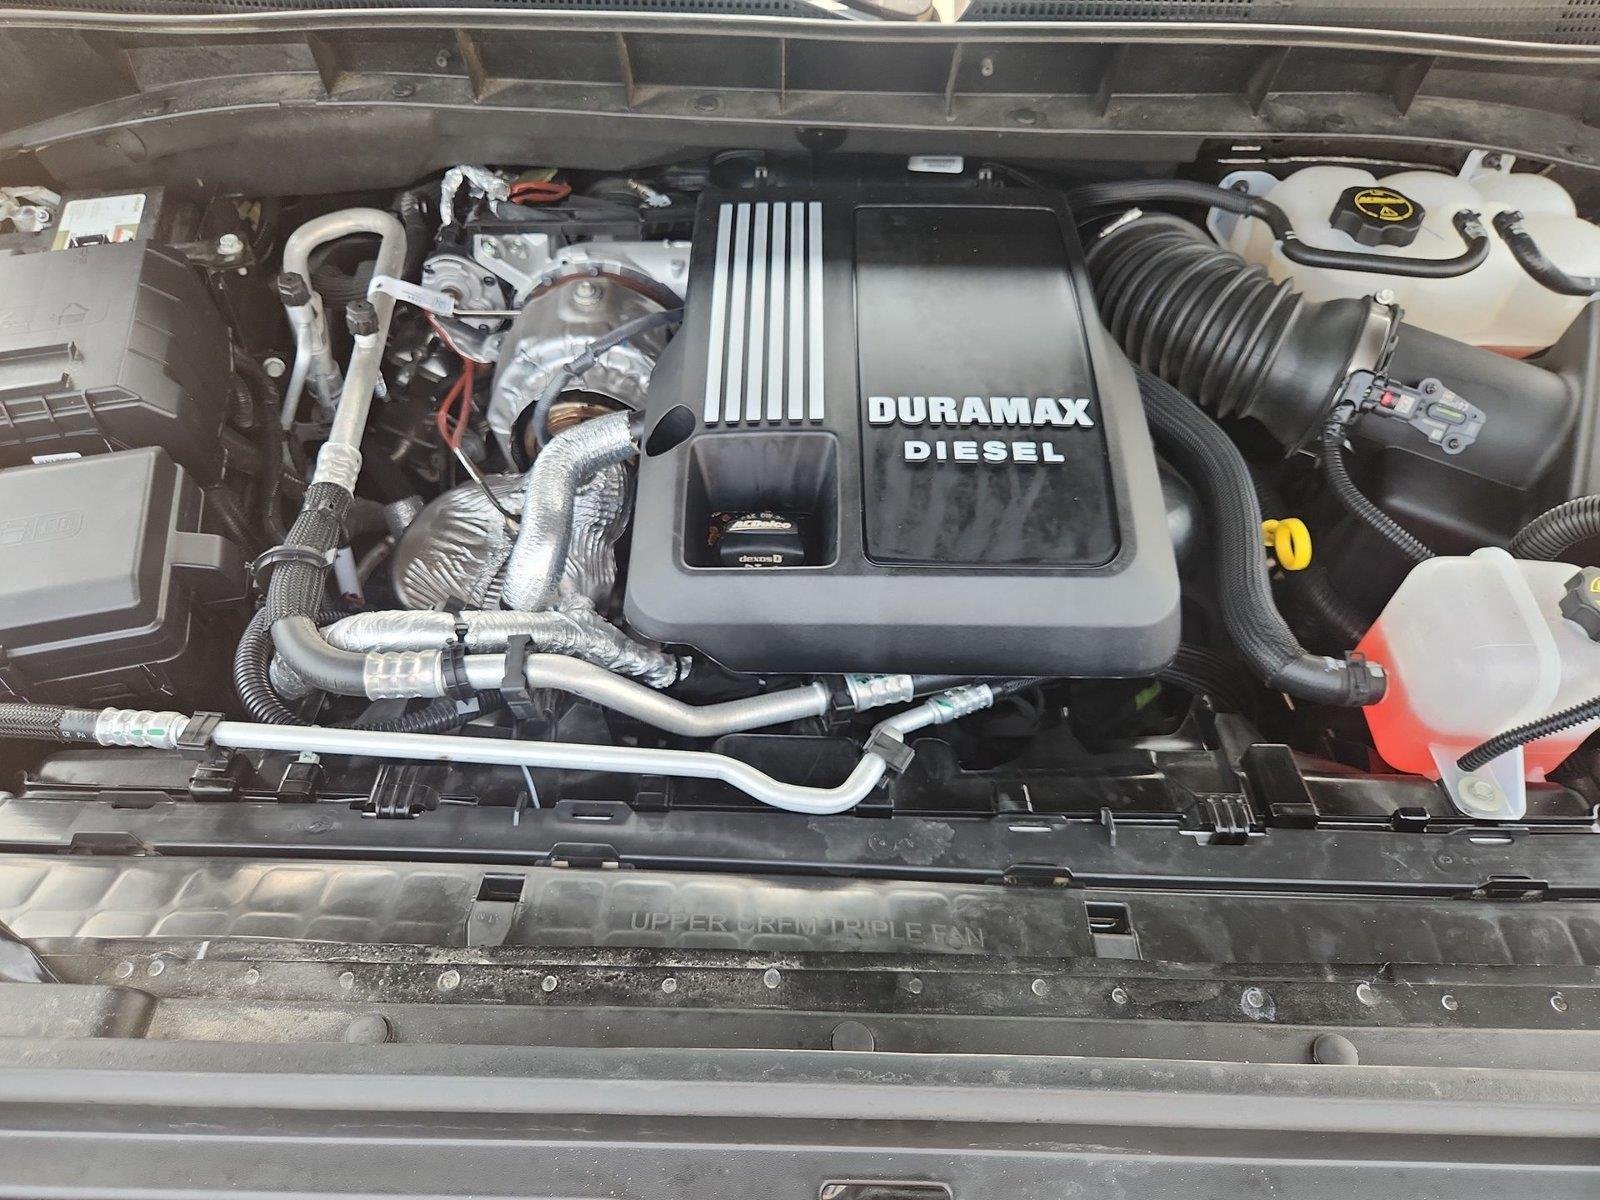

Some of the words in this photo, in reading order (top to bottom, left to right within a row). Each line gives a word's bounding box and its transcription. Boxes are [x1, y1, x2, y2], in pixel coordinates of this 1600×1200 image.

[868, 396, 1095, 427] DURAMAX
[904, 440, 1066, 463] DIESEL
[729, 520, 792, 531] ACDelco
[630, 911, 728, 932] UPPER
[827, 917, 922, 940] TRIPLE
[931, 923, 984, 948] FAN
